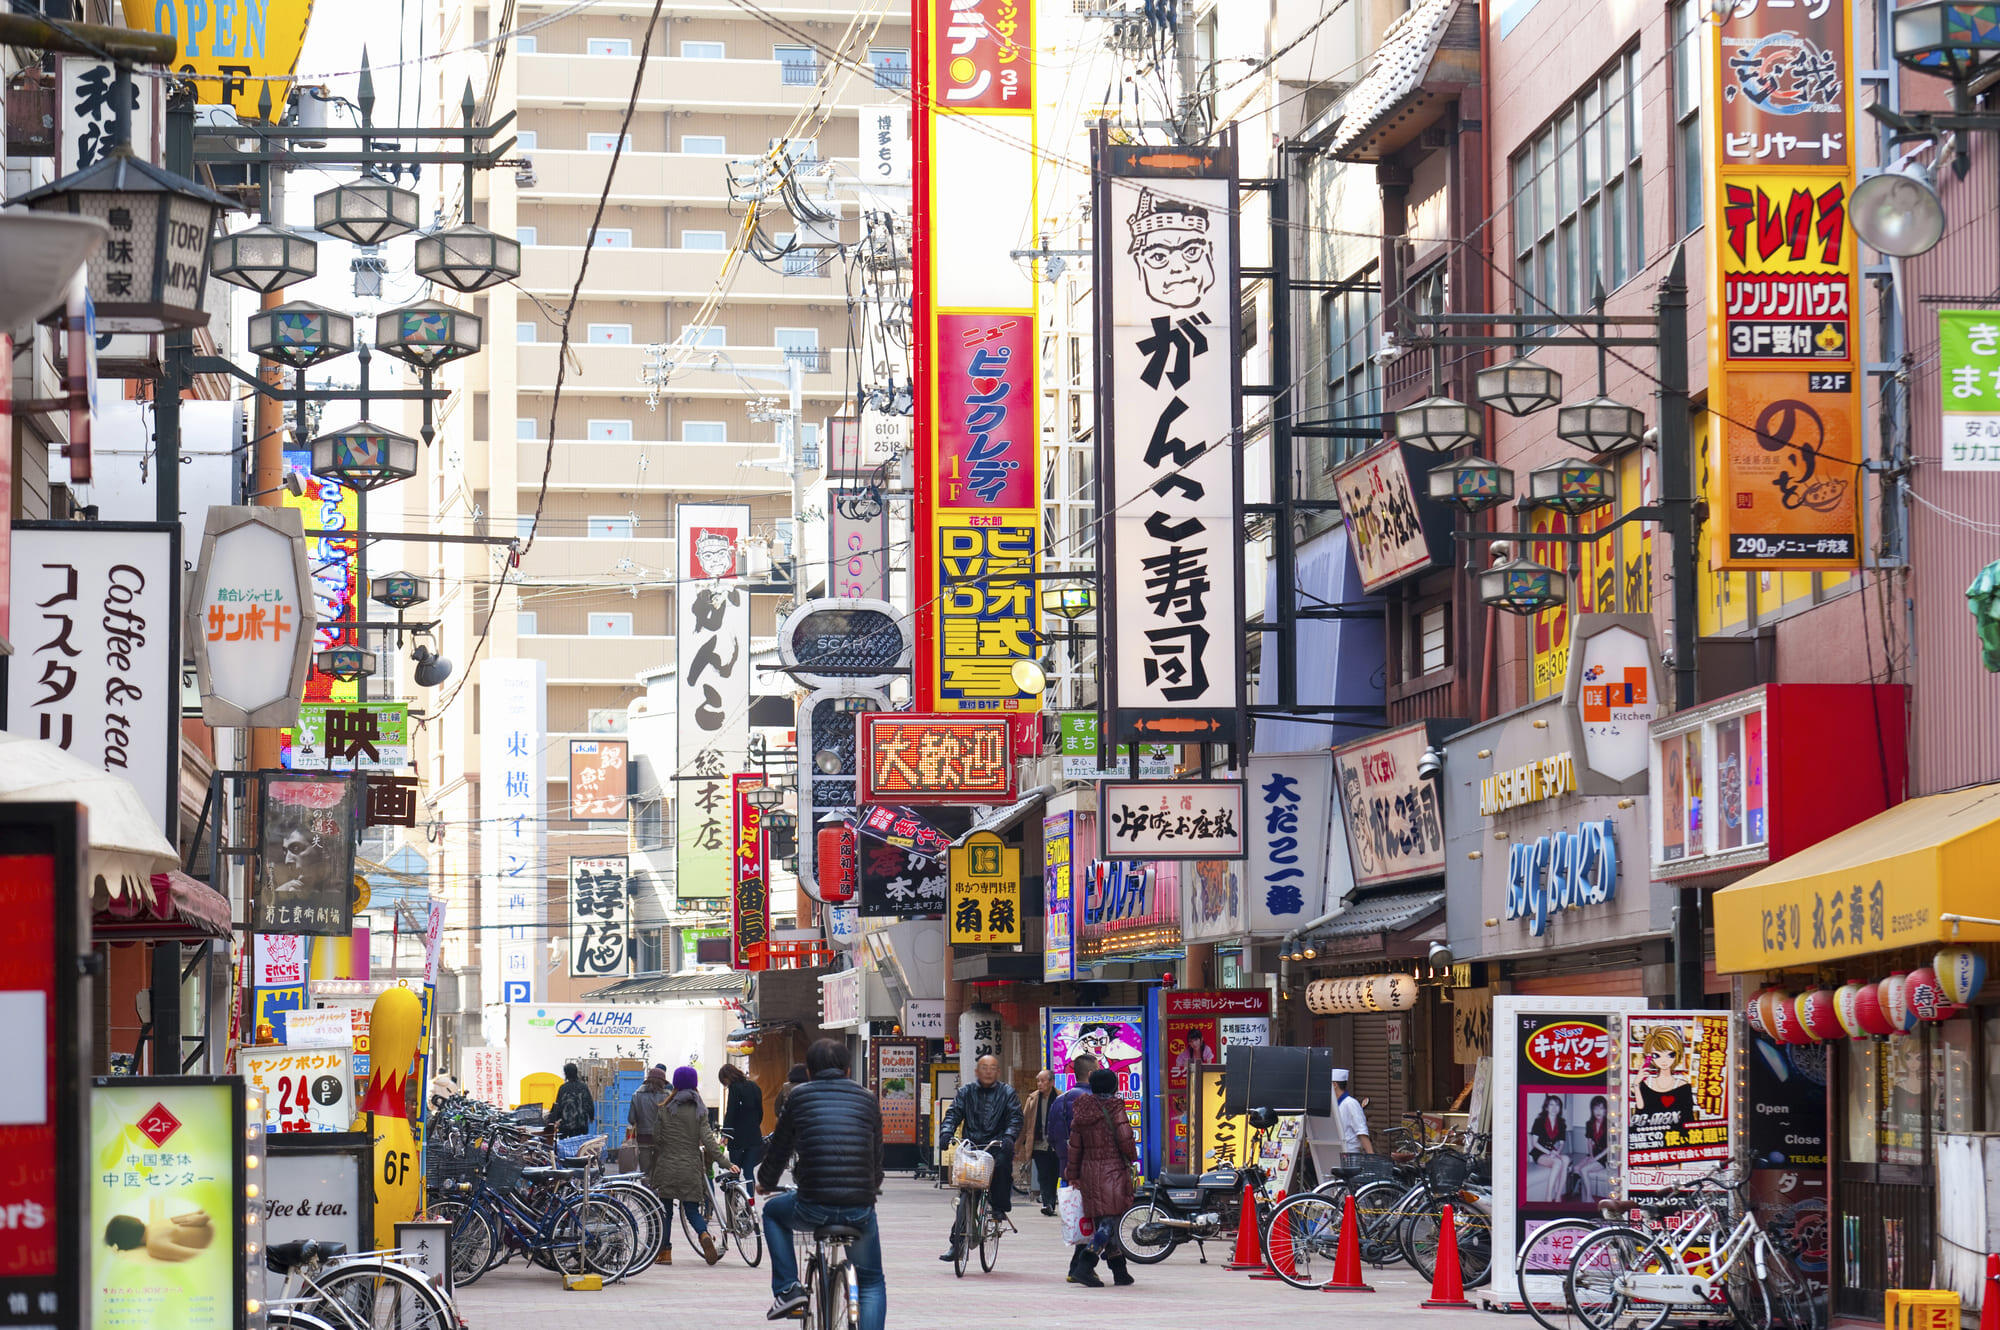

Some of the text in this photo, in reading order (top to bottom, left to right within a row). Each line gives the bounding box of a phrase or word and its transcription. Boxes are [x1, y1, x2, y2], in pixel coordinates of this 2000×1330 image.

[155, 0, 269, 58] OPEN
[1000, 70, 1017, 100] 3F
[1726, 132, 1843, 159] ビリヤード
[168, 218, 204, 251] TORI
[1724, 181, 1845, 267] テレクラ
[106, 206, 133, 295] 鳥味家
[165, 258, 200, 293] MIYA
[1726, 281, 1848, 315] リンリンハウス
[962, 320, 1017, 348] ニュー
[1731, 325, 1812, 354] 3F受付
[1821, 375, 1846, 390] 2F
[964, 347, 1019, 503] ピンクレディ
[947, 454, 963, 502] 1F
[969, 516, 1003, 526] 花太郎
[941, 528, 985, 616] DVD
[986, 528, 1033, 616] ビデオ
[103, 564, 146, 773] Coffee & tea.
[1613, 711, 1651, 721] Kitchen
[575, 744, 597, 752] Asahi
[877, 728, 1003, 787] 大歓迎
[1480, 752, 1577, 817] AMUSEMENT SPOT
[1261, 772, 1305, 916] 大だこ一番
[840, 832, 851, 896] 大阪初上陸
[955, 881, 1017, 894] 串かつ専門料理
[1762, 903, 1801, 952] にぎり
[586, 1012, 633, 1026] ALPHA
[589, 1026, 645, 1035] La LOGISTIQUE
[1552, 1028, 1584, 1039] New
[1228, 1036, 1262, 1046] マッサージ
[1534, 1034, 1609, 1058] キャバクラ
[278, 1075, 311, 1115] 24
[1756, 1103, 1790, 1115] Open
[147, 1117, 172, 1133] 2F
[1784, 1134, 1821, 1145] Close
[126, 1153, 193, 1167] 中国整体
[384, 1150, 411, 1187] 6F
[103, 1171, 215, 1188] 中医センター
[315, 1201, 348, 1217] tea.
